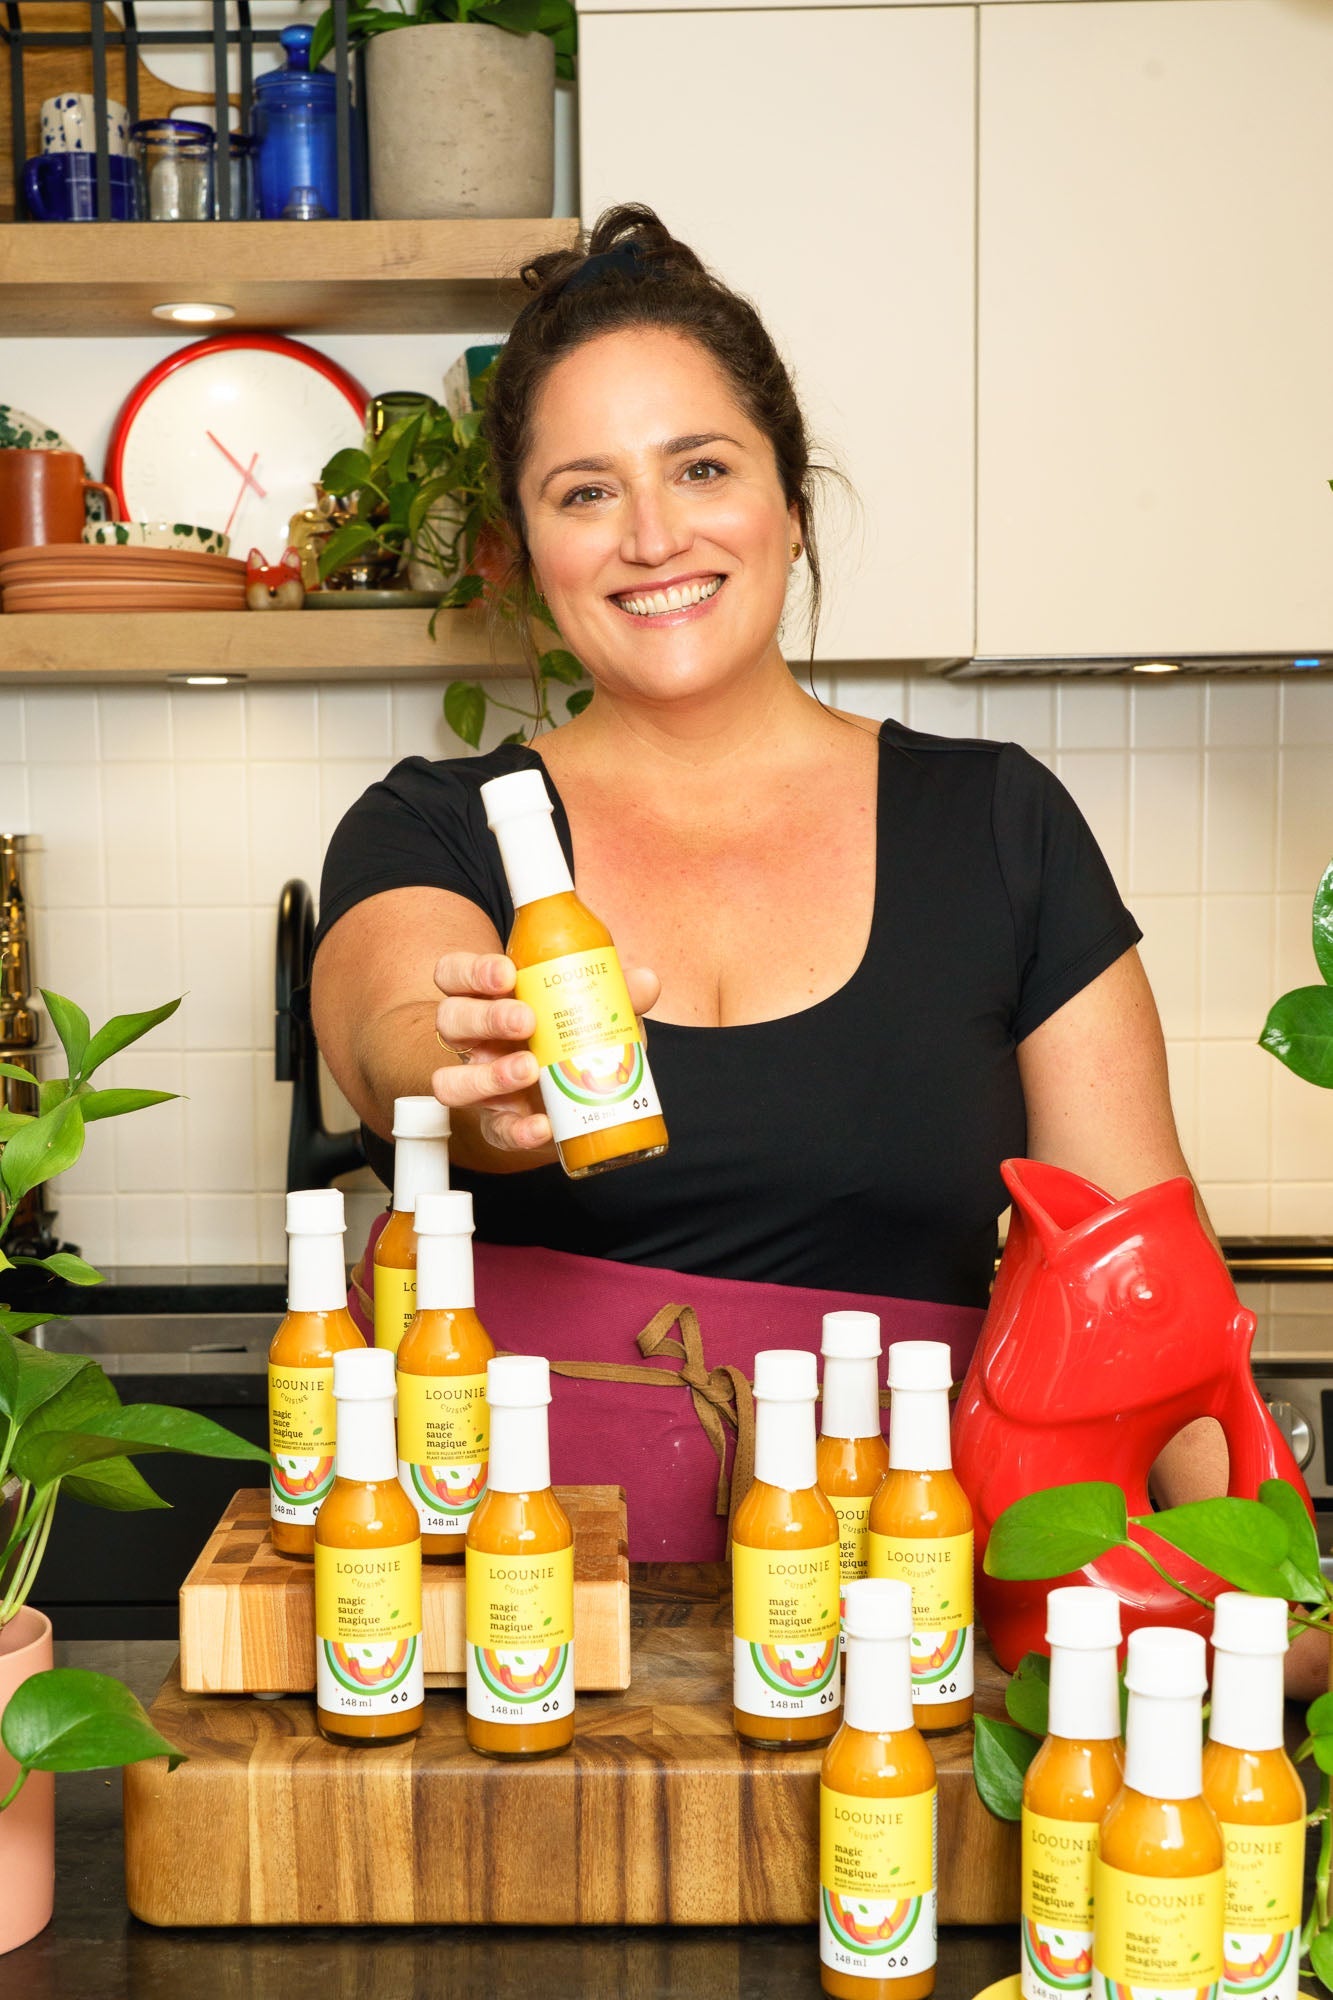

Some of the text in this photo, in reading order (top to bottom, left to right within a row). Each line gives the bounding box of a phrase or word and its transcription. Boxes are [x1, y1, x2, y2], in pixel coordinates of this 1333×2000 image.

[544, 962, 609, 987] LOOUNIE
[582, 1110, 601, 1124] 148
[272, 1378, 324, 1391] LOOUNIE
[281, 1392, 309, 1405] CUISINE
[426, 1387, 485, 1400] LOOUNIE
[441, 1403, 472, 1414] CUISINE
[273, 1410, 292, 1420] magic
[273, 1419, 290, 1428] sauce
[426, 1420, 454, 1431] magic
[274, 1428, 303, 1439] magique
[426, 1431, 453, 1439] sauce
[426, 1440, 468, 1450] magique
[274, 1504, 296, 1516] 148 ml
[428, 1518, 459, 1526] 148 ml
[888, 1551, 951, 1563] LOOUNIE
[337, 1561, 400, 1574] LOOUNIE
[768, 1560, 830, 1575] LOOUNIE
[902, 1566, 936, 1578] CUISINE
[490, 1568, 554, 1581] LOOUNIE
[352, 1578, 386, 1589] CUISINE
[784, 1577, 818, 1590] CUISINE
[505, 1584, 540, 1596] CUISINE
[338, 1596, 366, 1606] magic
[769, 1598, 799, 1608] magic
[338, 1607, 364, 1615] sauce
[490, 1603, 519, 1613] magic
[769, 1608, 797, 1616] sauce
[338, 1616, 380, 1626] magique
[490, 1613, 517, 1621] sauce
[769, 1617, 812, 1627] magique
[490, 1623, 533, 1633] magique
[340, 1698, 372, 1707] 148 ml
[770, 1700, 803, 1709] 148 ml
[491, 1705, 523, 1715] 148 ml
[834, 1808, 904, 1825] LOOUNIE
[849, 1826, 885, 1841] CUISINE
[835, 1844, 863, 1857] magic
[835, 1855, 861, 1867] sauce
[835, 1866, 878, 1879] magique
[1032, 1869, 1059, 1883] magic
[1032, 1880, 1057, 1894] sauce
[1032, 1892, 1074, 1908] magique
[1126, 1890, 1206, 1908] LOOUNIE
[1126, 1931, 1161, 1945] magic
[1126, 1943, 1158, 1955] sauce
[835, 1953, 867, 1967] 148 ml
[1126, 1954, 1178, 1969] magique
